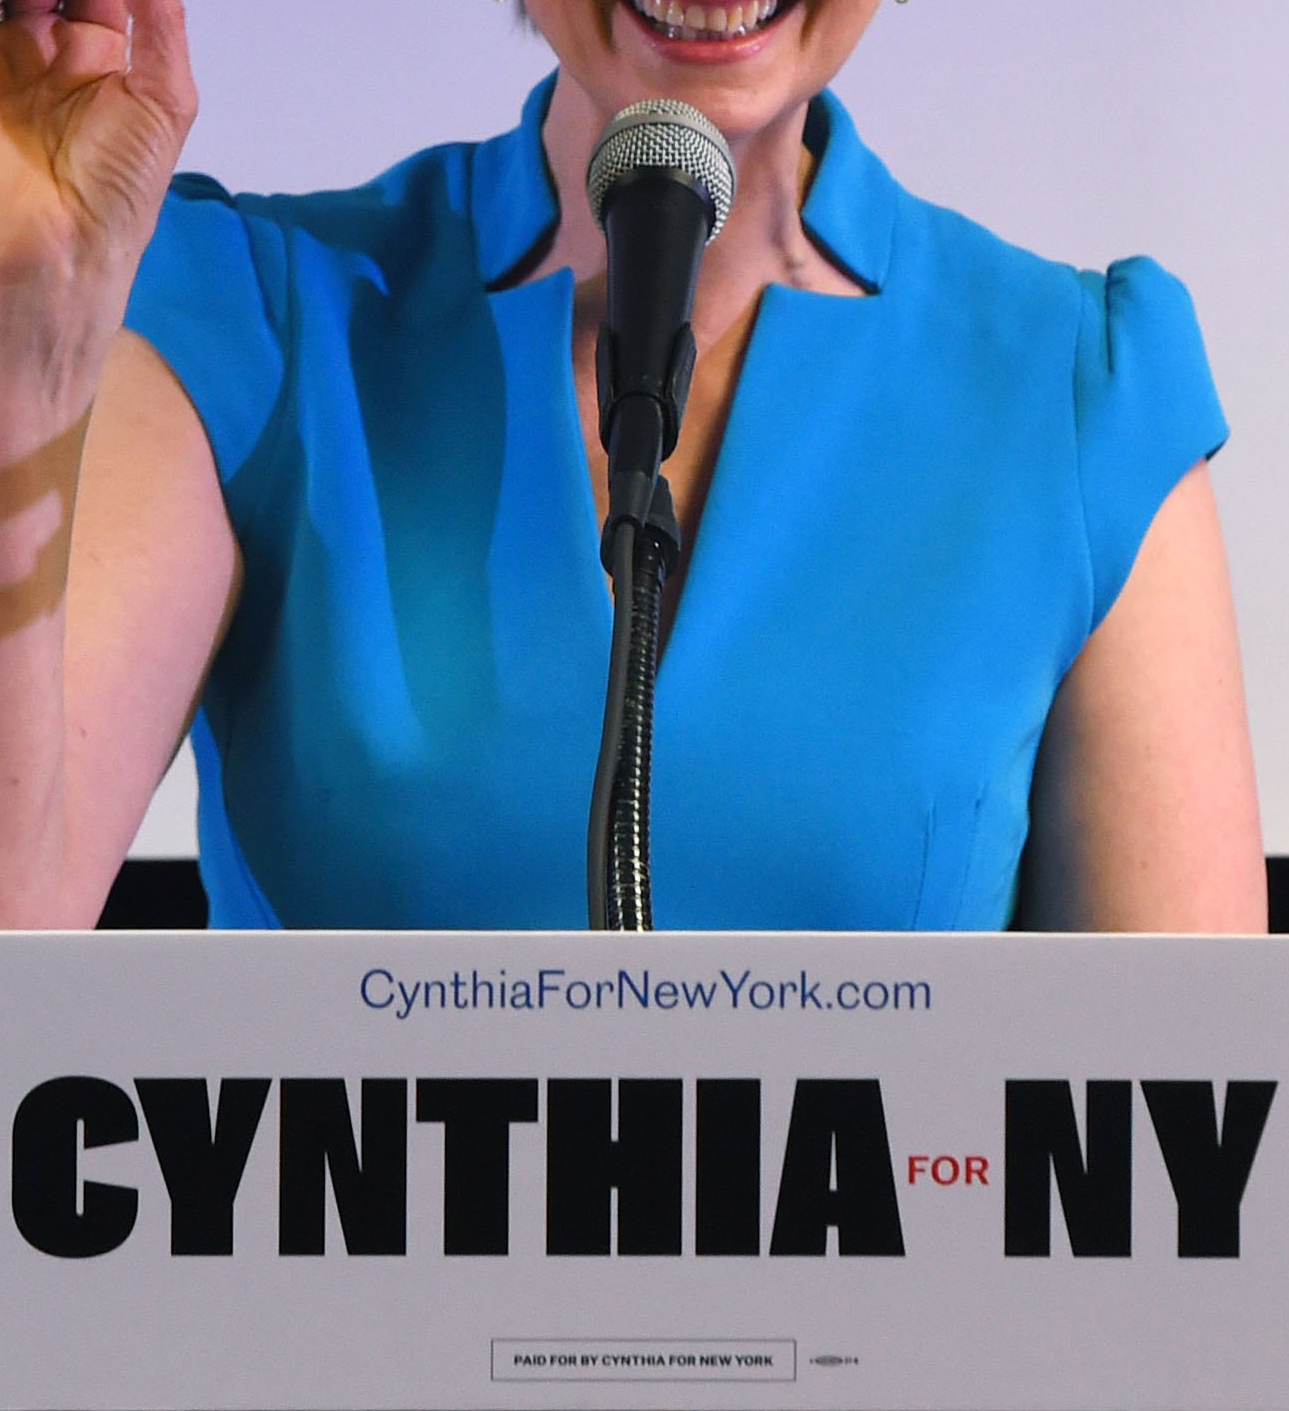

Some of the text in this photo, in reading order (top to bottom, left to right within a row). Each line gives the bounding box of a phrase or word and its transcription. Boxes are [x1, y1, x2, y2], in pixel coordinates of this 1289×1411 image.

[359, 967, 933, 1019] CynthiaForNewYork.com
[10, 1075, 1279, 1260] CYNTHIA FOR NY
[513, 1354, 774, 1367] PAID FOR BY CYNTHIA FOR NEW YORK
